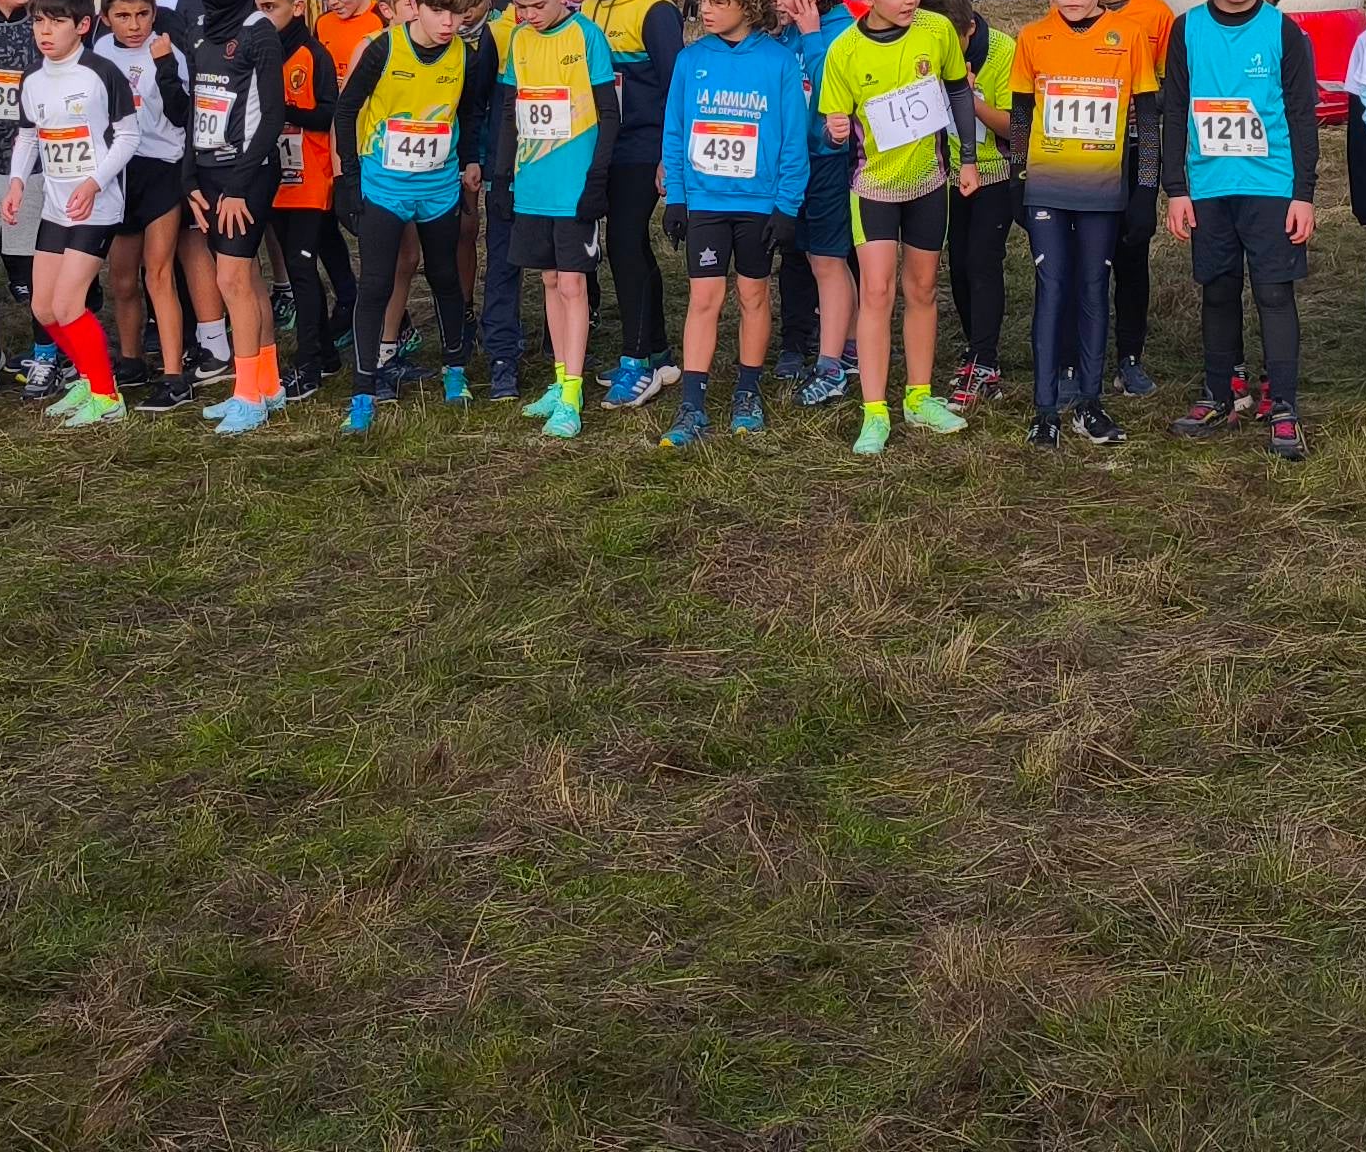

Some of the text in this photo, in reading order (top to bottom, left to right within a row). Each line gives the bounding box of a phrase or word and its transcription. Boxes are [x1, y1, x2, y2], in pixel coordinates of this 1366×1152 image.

[697, 88, 768, 112] LA ARMUÑA
[889, 91, 929, 128] 45
[530, 104, 553, 124] 89
[718, 107, 762, 120] DEPORTIVO
[1053, 99, 1112, 125] 1111
[195, 114, 218, 134] 60
[1202, 116, 1263, 140] 1218
[44, 141, 92, 163] 1272
[398, 136, 439, 158] 441
[703, 138, 746, 161] 439
